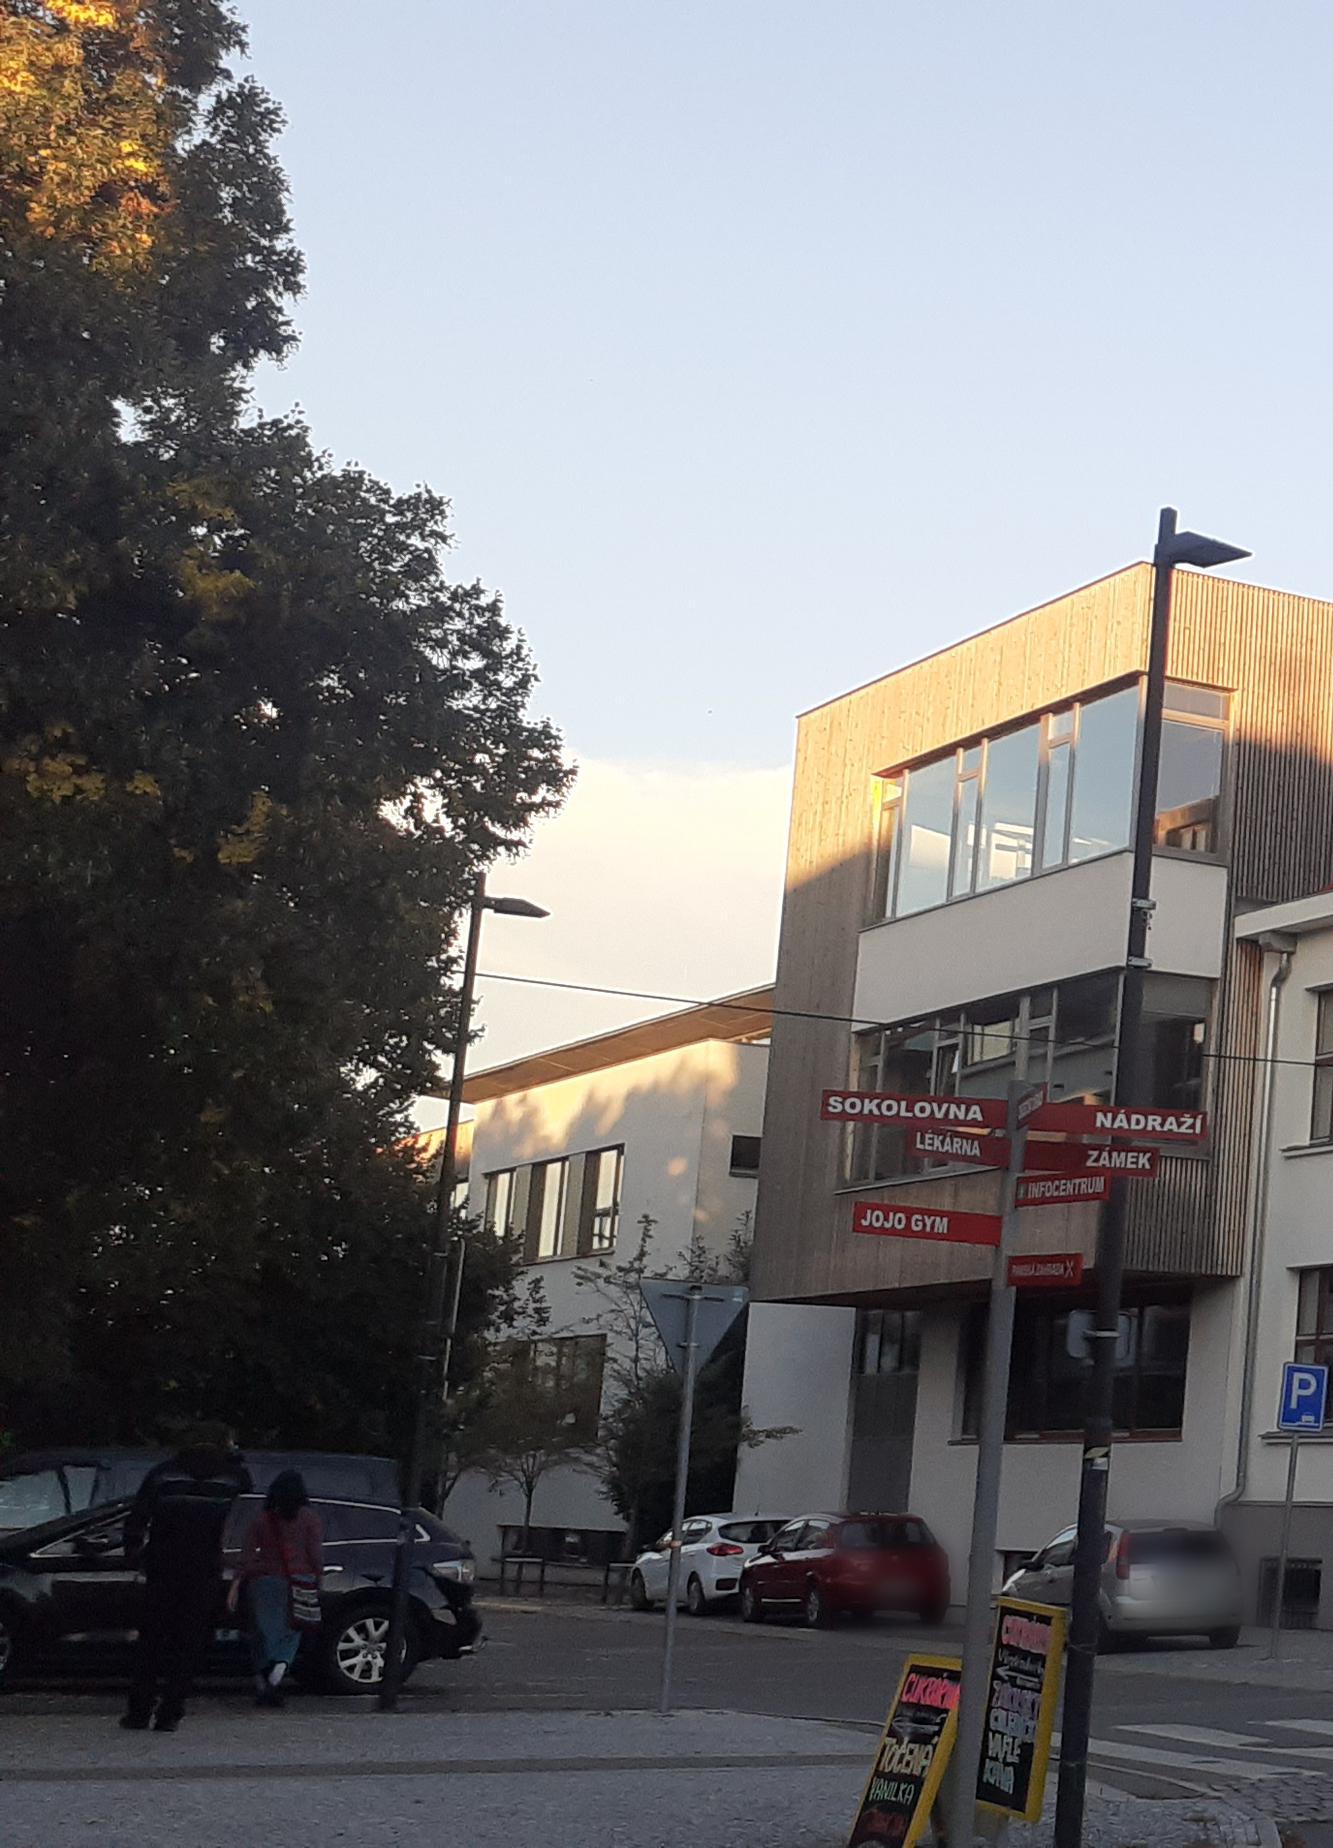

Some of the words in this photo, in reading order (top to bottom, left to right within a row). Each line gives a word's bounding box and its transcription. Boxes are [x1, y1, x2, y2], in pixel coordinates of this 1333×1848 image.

[827, 1096, 984, 1122] SOKOLOVNA
[1095, 1109, 1204, 1134] NÁDRAŽÍ
[916, 1130, 981, 1157] LÉKÁRNA
[1085, 1146, 1152, 1170] ZÁMEK
[1027, 1176, 1105, 1199] INFOCENTRUM
[861, 1208, 906, 1230] JOJO
[911, 1213, 949, 1234] GYM
[1289, 1372, 1317, 1409] P
[868, 1777, 915, 1806] VANILKA
